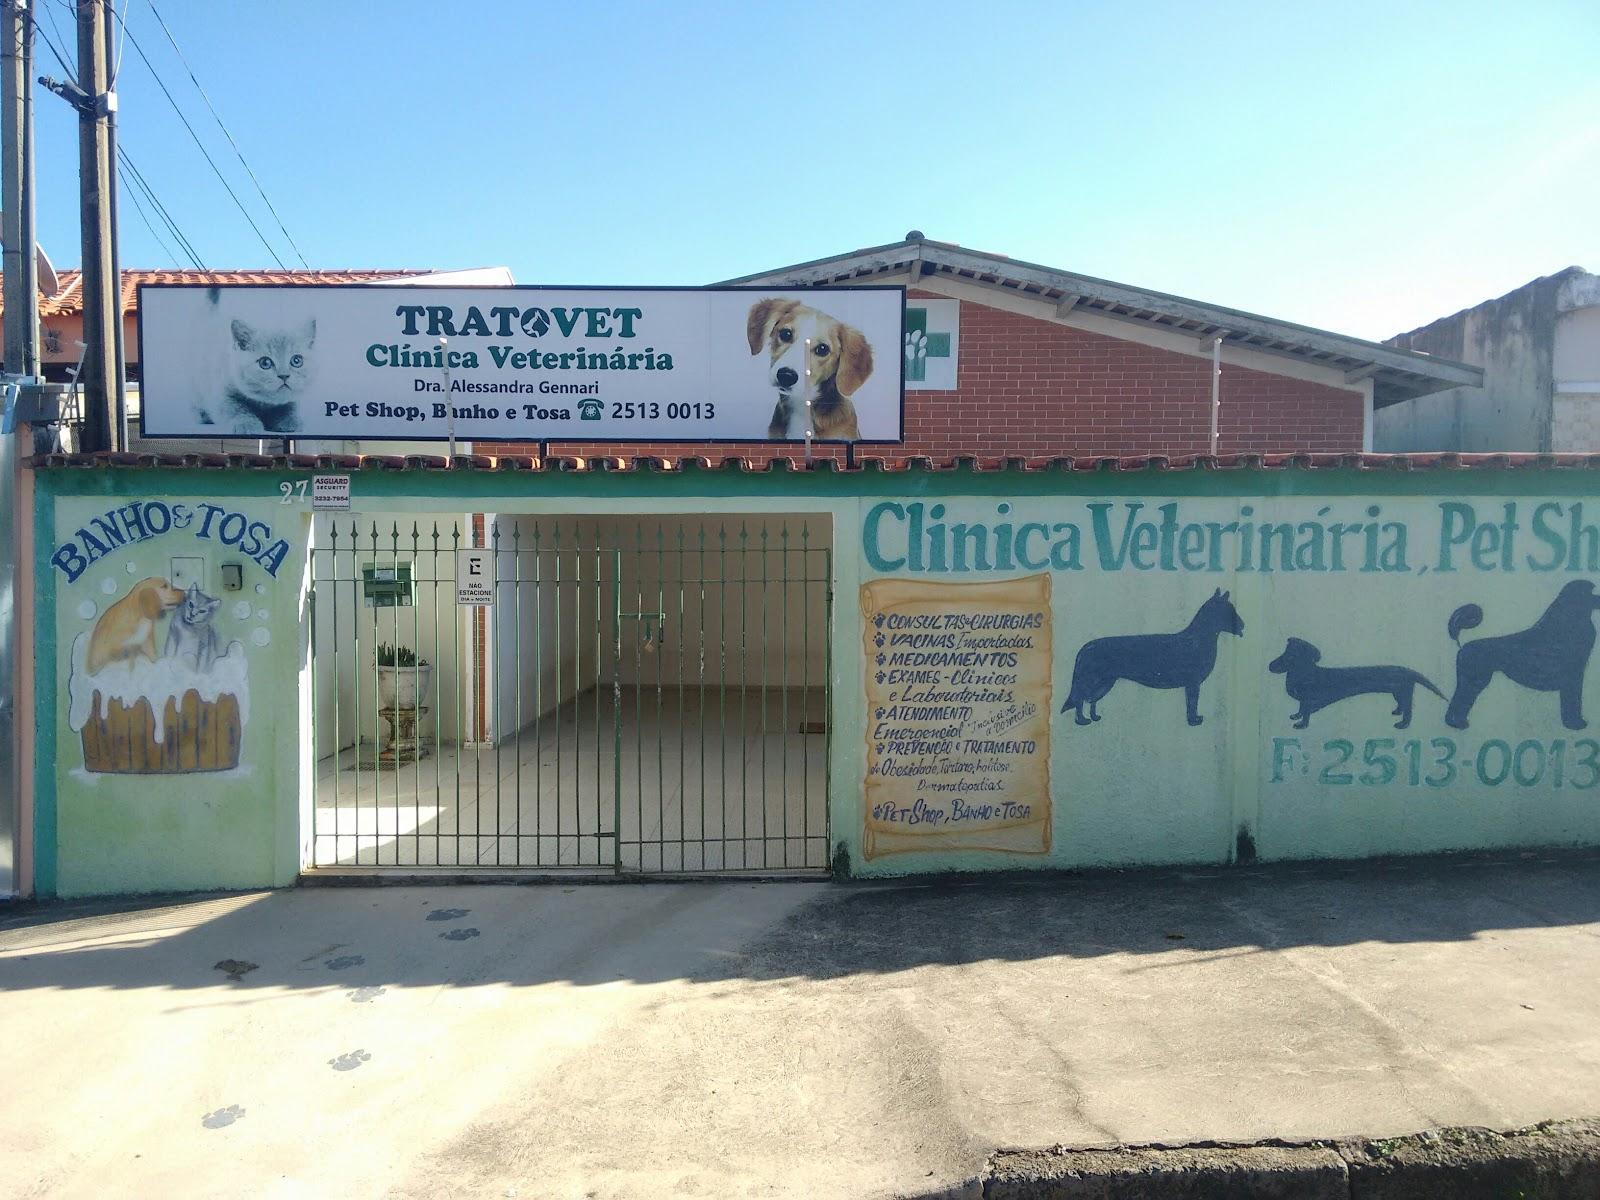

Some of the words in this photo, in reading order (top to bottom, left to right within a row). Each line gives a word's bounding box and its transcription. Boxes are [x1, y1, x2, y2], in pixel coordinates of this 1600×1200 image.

[396, 305, 643, 338] TRATOVET
[366, 344, 479, 369] Clínica
[487, 346, 674, 371] Veterinária
[414, 379, 445, 393] Dra.
[450, 380, 534, 394] Alessandra
[539, 381, 599, 394] Gennari
[325, 402, 360, 417] Pet
[365, 402, 426, 421] Shop,
[505, 410, 517, 419] e
[523, 404, 571, 420] Tosa
[611, 402, 660, 419] 2513
[667, 402, 715, 419] 0013
[280, 480, 309, 505] 27
[51, 501, 171, 584] BANHO
[195, 502, 290, 579] TOSA
[1086, 502, 1428, 575] Veterinária,
[1433, 502, 1520, 573] Pet
[886, 614, 966, 630] CONSULTAS
[970, 612, 1044, 630] CIRURGIAS
[890, 633, 955, 649] VACINAS
[888, 652, 1018, 667] MEDICAMENTOS
[888, 669, 941, 685] EXAMES
[889, 691, 897, 701] e
[885, 705, 973, 721] ATENDIMENTO
[963, 740, 1036, 754] TRATAMENTO
[1318, 737, 1600, 789] 2513-0013
